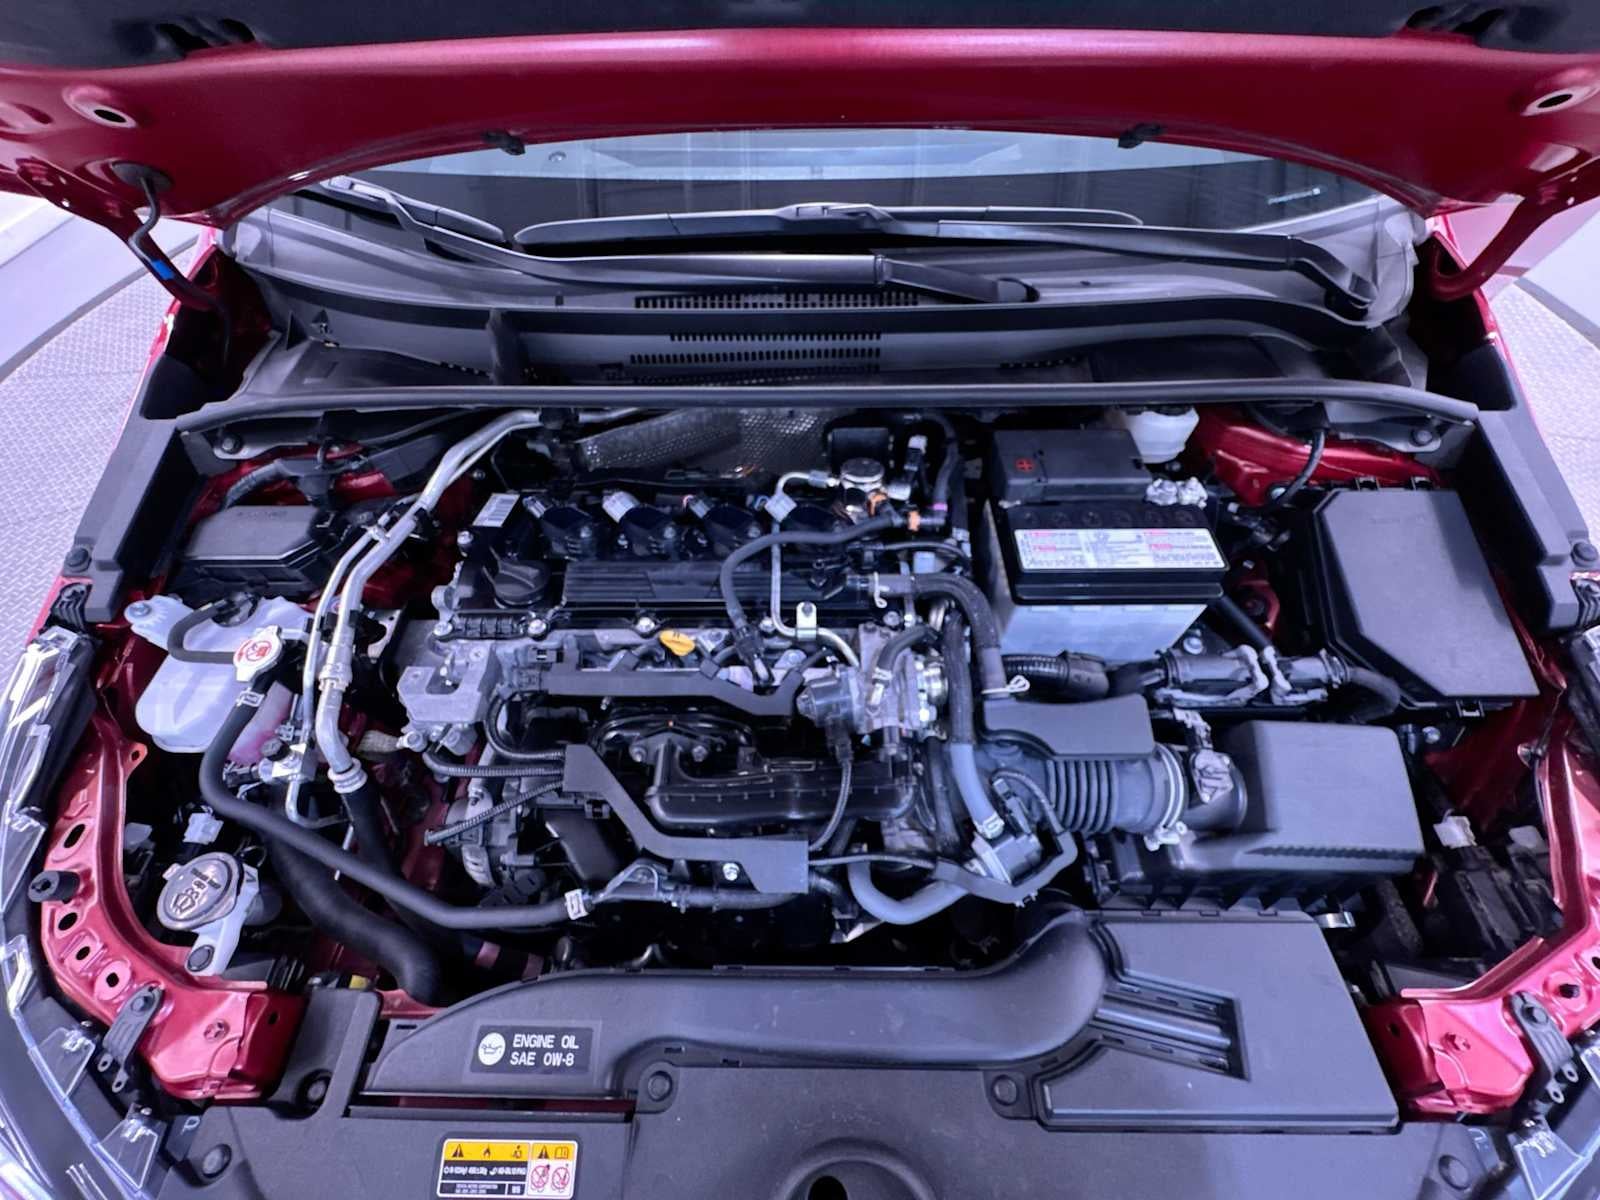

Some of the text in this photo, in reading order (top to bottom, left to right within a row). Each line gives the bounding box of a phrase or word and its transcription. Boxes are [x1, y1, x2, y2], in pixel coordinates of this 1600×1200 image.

[512, 1033, 579, 1049] ENGINE OIL
[510, 1051, 575, 1067] SAE 0W-8
